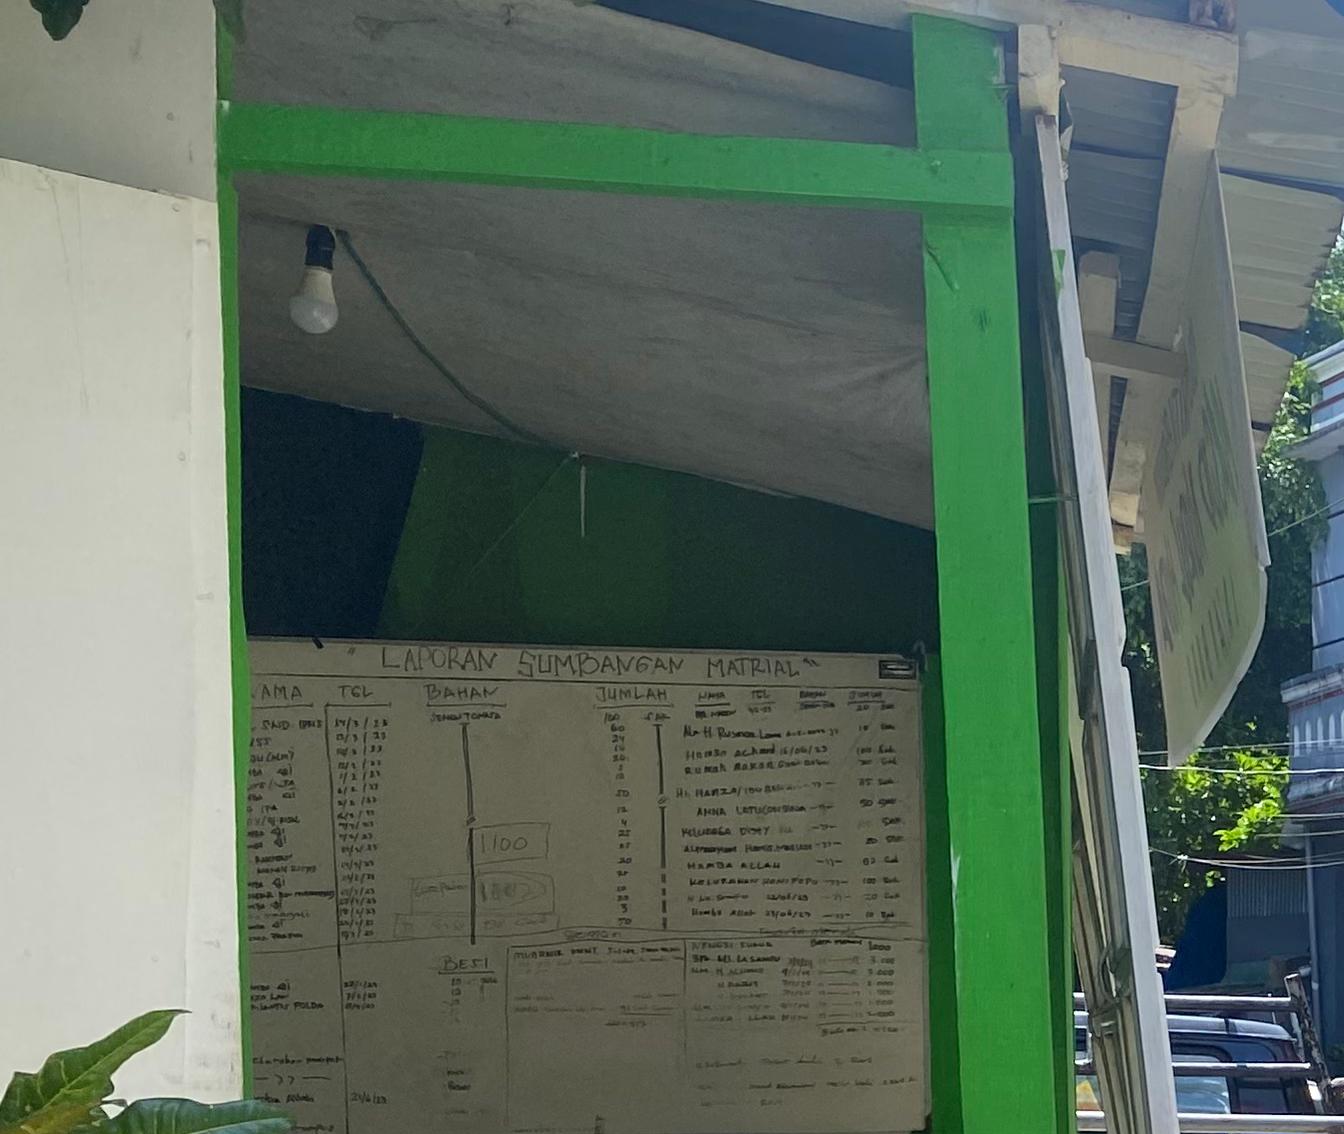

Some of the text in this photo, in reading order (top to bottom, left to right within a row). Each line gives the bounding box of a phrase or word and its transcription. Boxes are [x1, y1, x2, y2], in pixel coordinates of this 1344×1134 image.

[381, 646, 499, 672] LAPORAN
[517, 650, 685, 679] SUMBANGAN
[338, 684, 374, 699] TGL
[424, 683, 501, 701] BAHAN
[594, 686, 668, 702] JUMLAH
